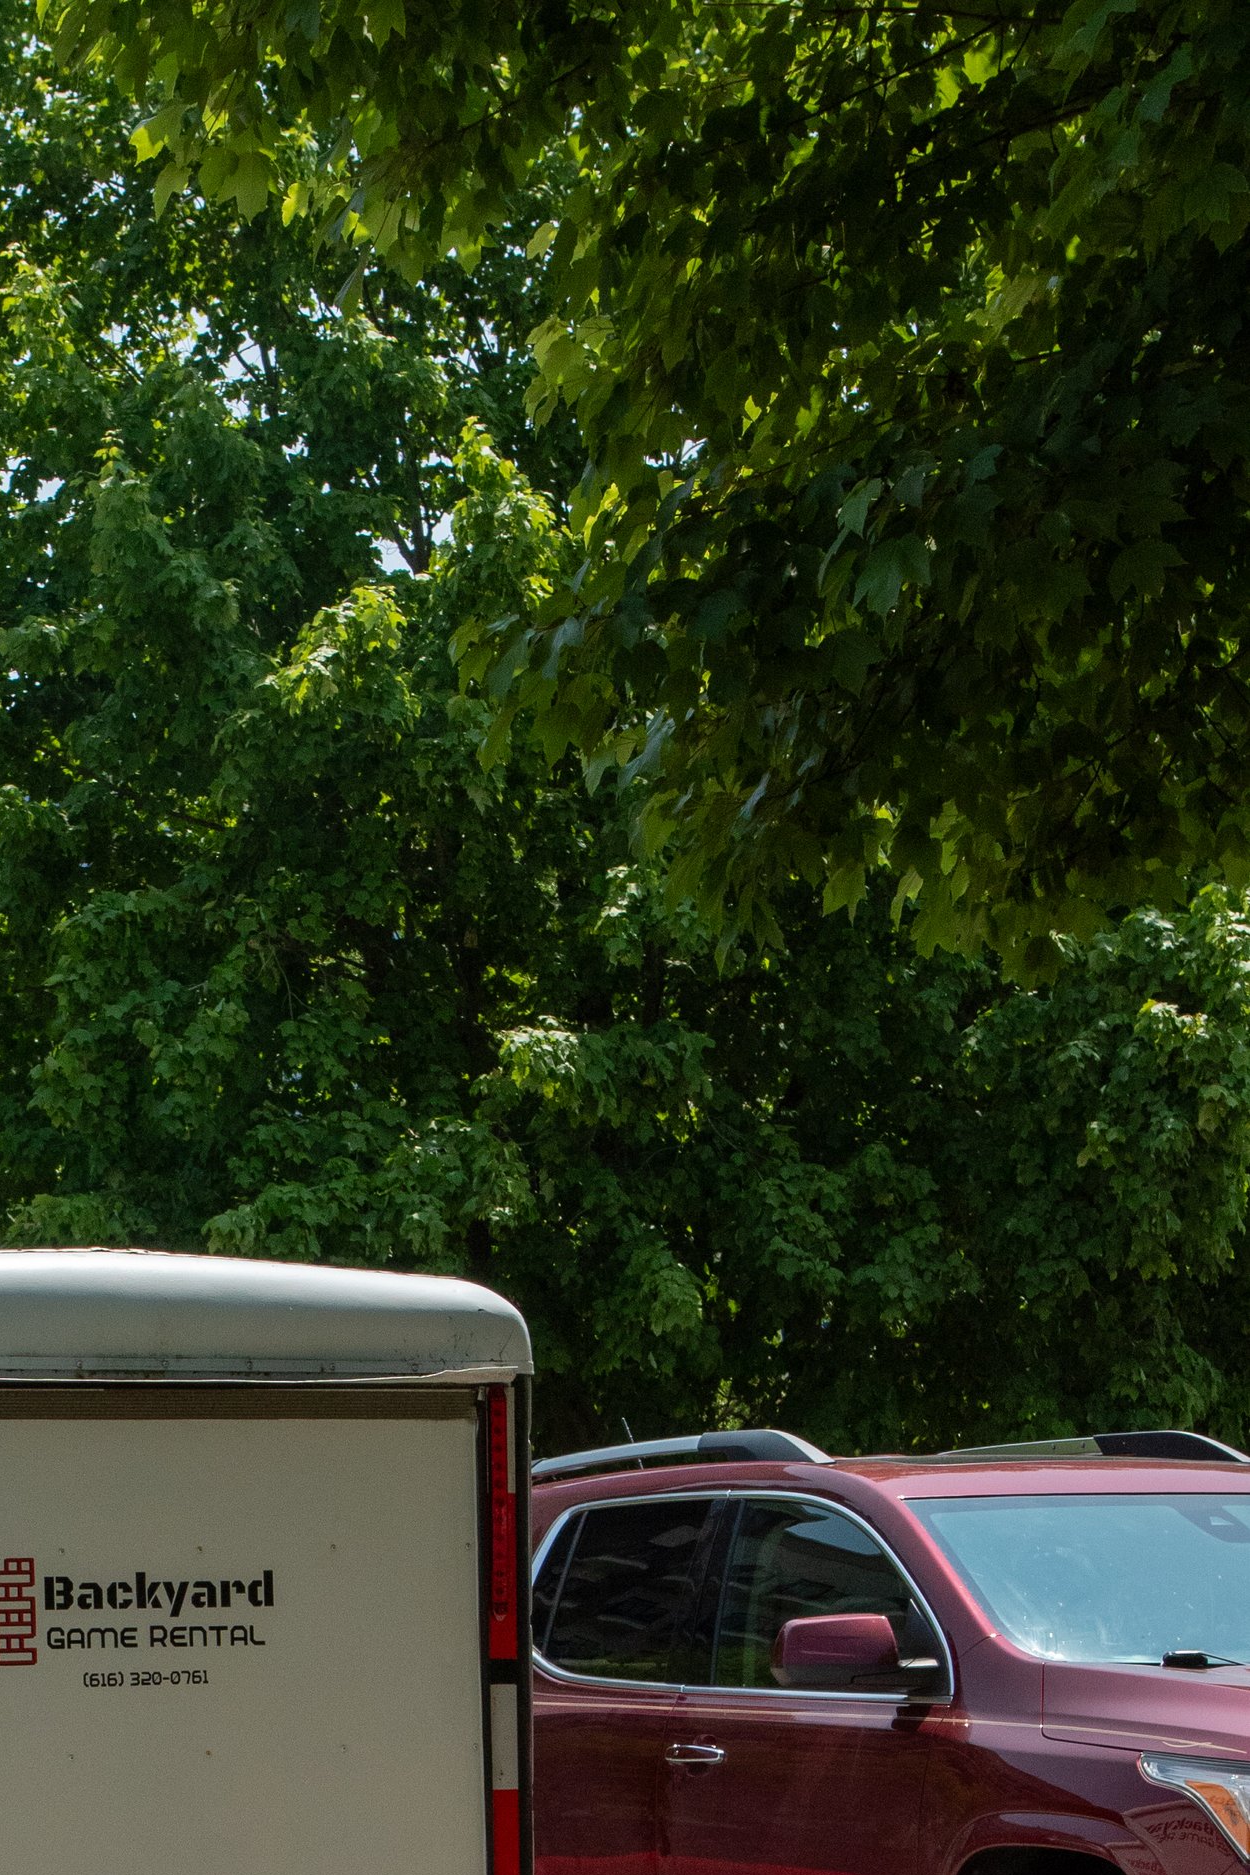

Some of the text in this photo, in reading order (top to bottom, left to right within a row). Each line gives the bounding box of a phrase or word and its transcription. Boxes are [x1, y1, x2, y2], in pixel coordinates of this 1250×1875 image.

[44, 1569, 274, 1618] Backyard
[46, 1624, 266, 1650] GAME RENTAL
[83, 1670, 209, 1687] (616) 320-0761
